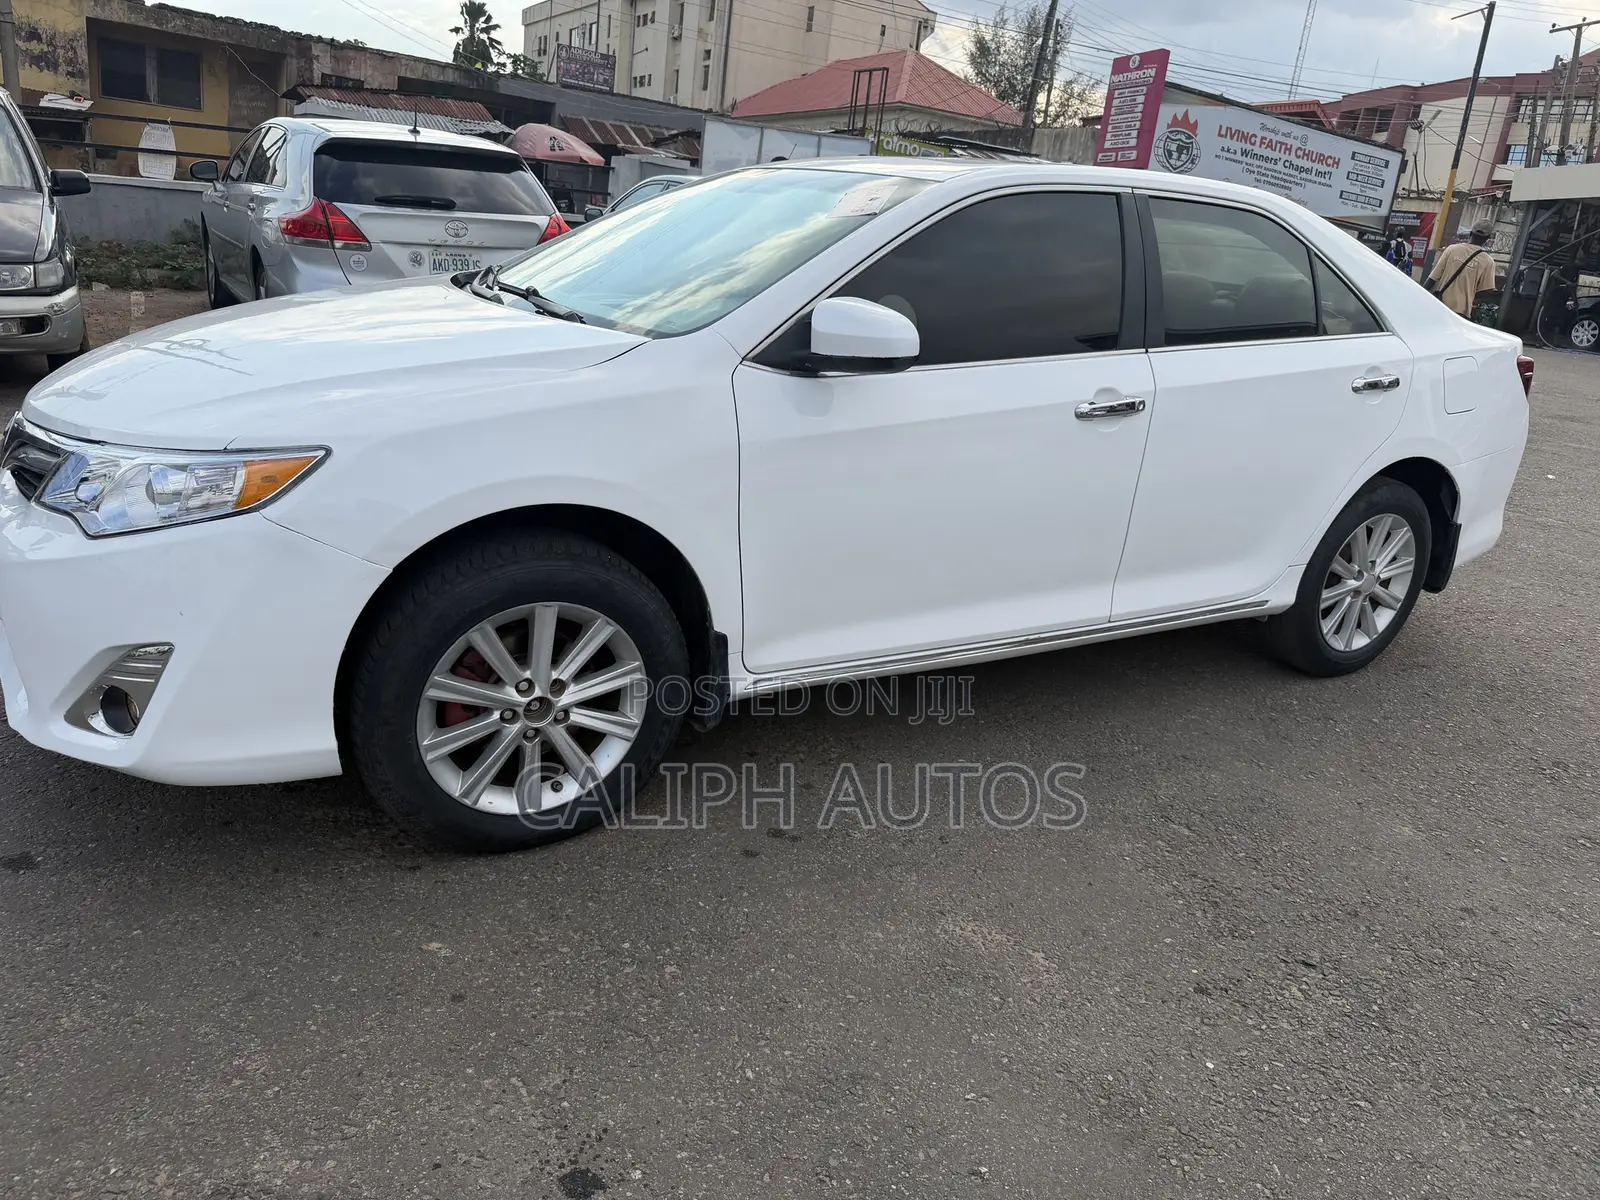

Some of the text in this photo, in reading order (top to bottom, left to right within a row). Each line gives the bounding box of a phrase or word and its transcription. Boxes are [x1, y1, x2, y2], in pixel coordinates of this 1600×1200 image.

[1110, 68, 1157, 83] NATHRON
[1217, 124, 1341, 170] LIVING FAITH CHURCH
[1220, 145, 1333, 181] a.k.a Winners' Chapel Int'l
